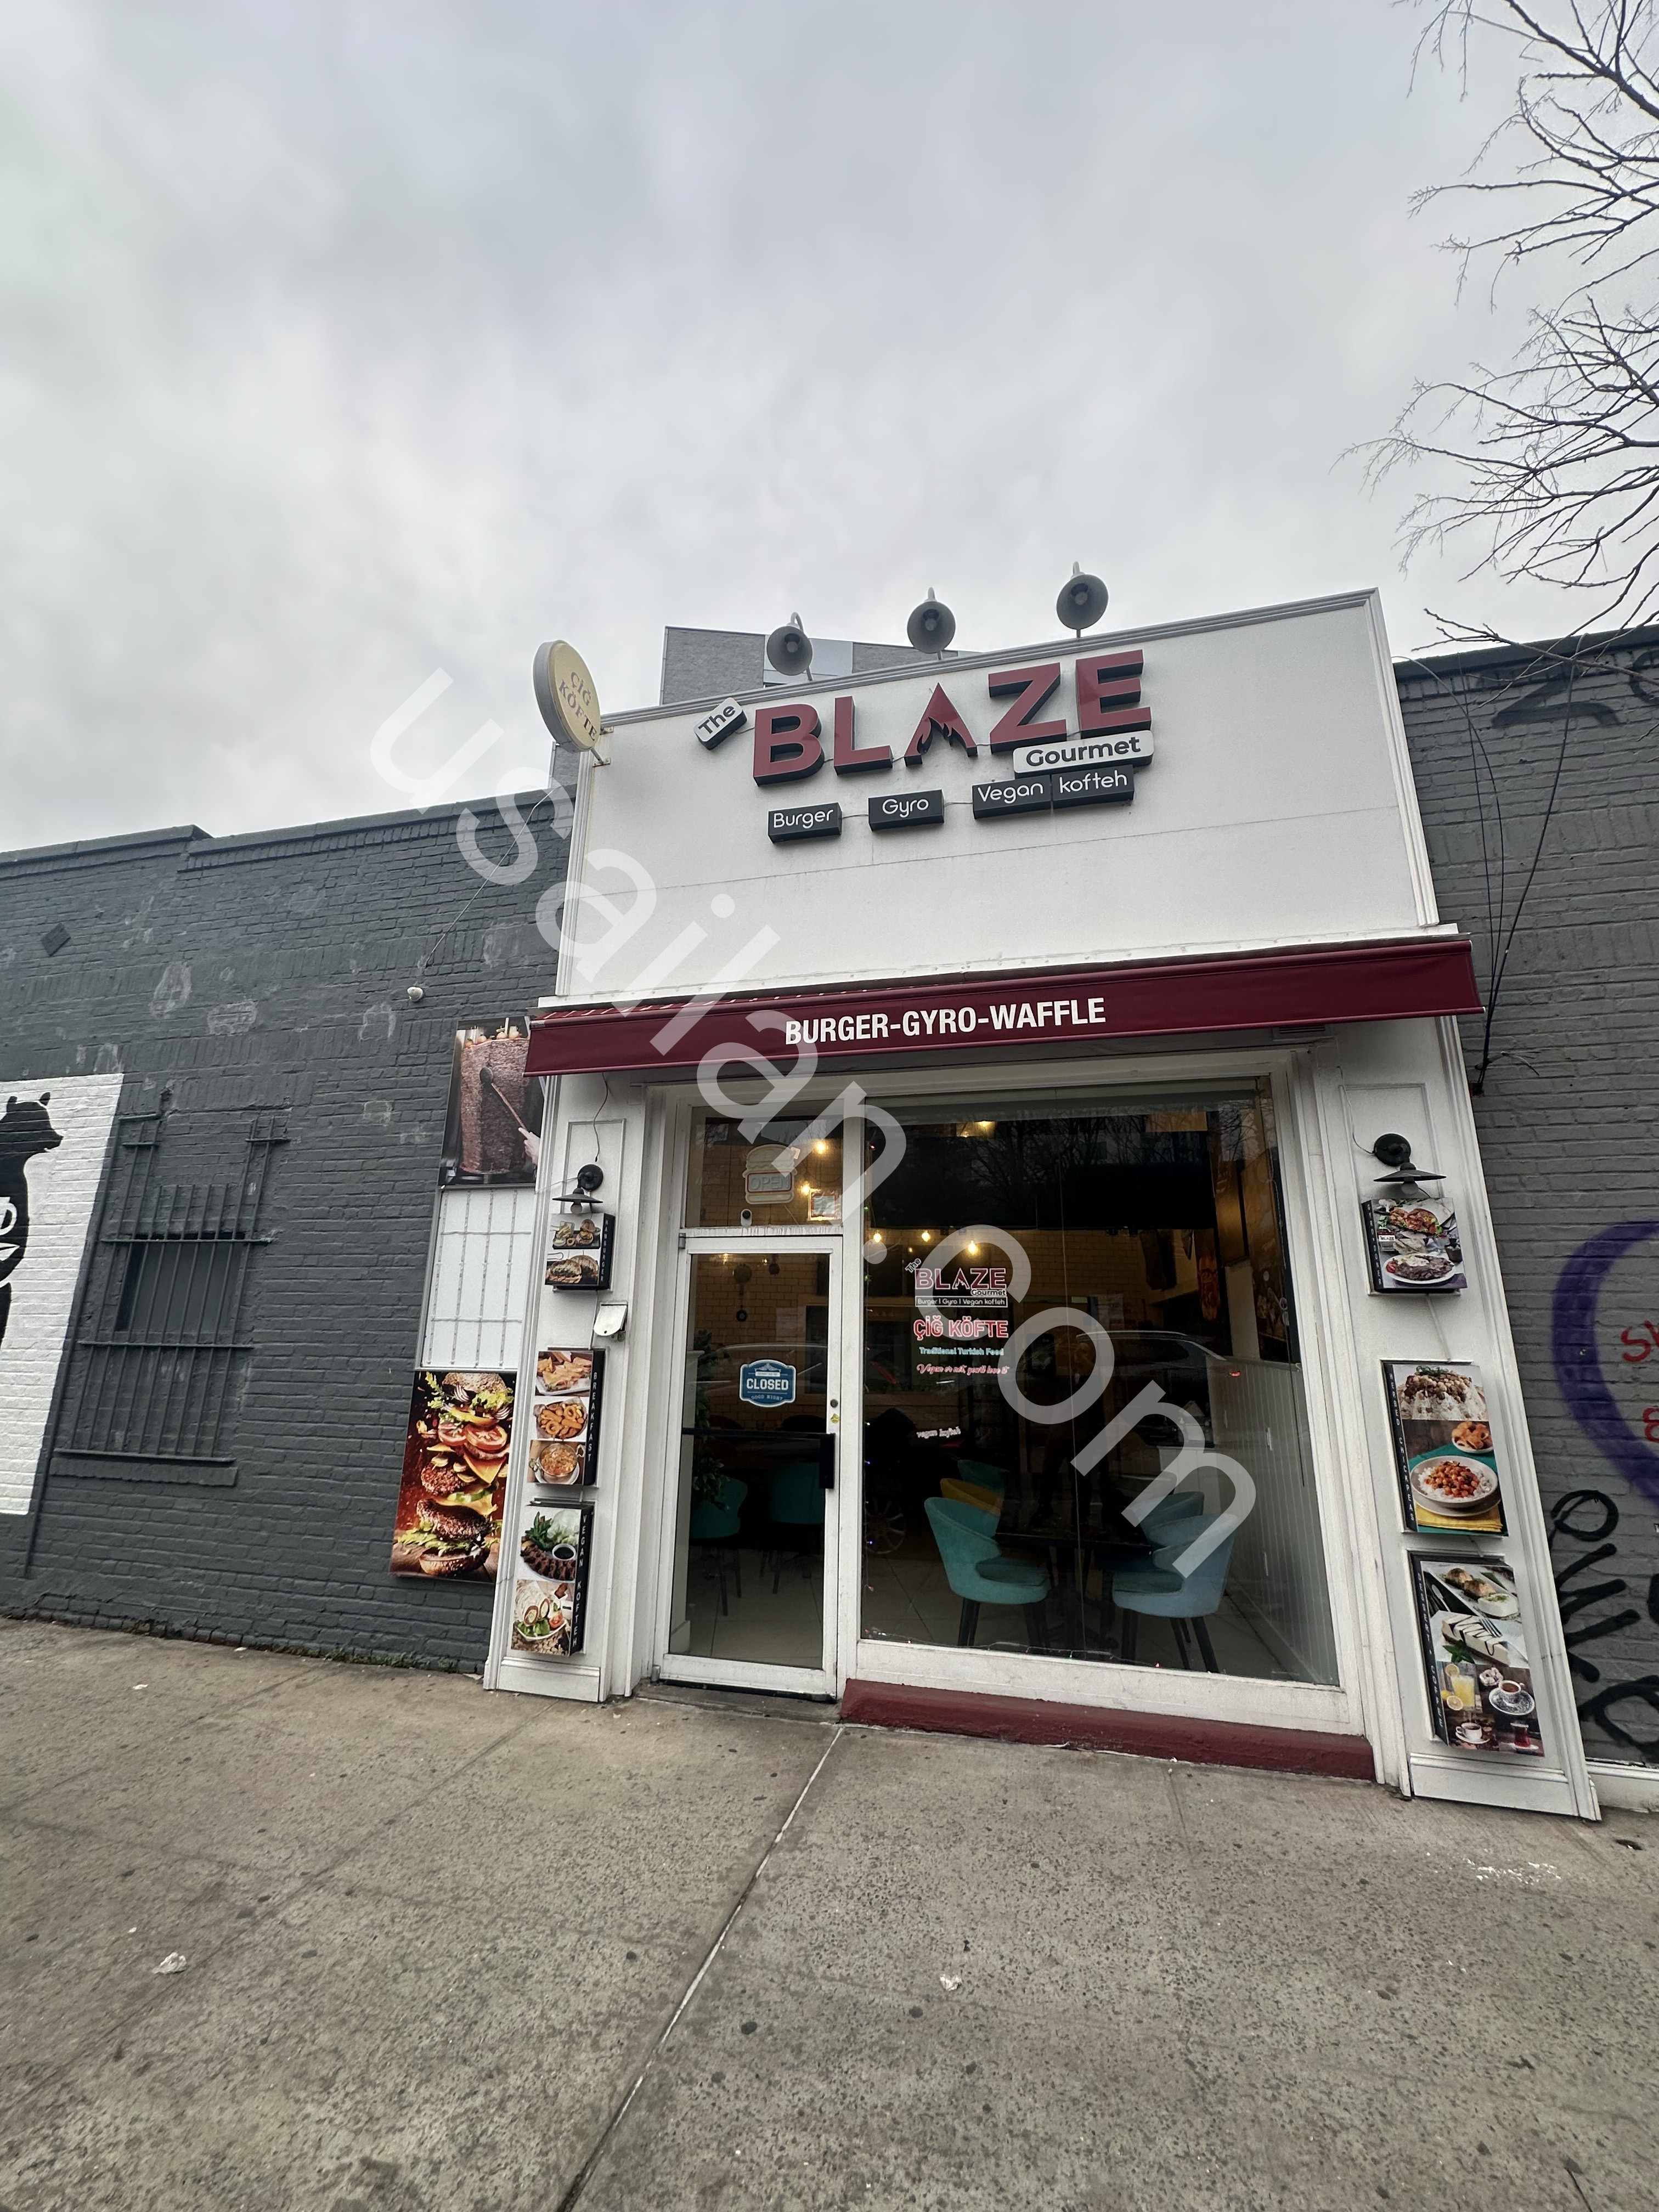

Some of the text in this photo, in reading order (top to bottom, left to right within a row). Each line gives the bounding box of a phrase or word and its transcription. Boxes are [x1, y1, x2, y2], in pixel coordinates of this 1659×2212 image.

[558, 679, 597, 741] KÖFTE
[698, 704, 735, 737] The
[753, 650, 1151, 785] BLAZE
[1026, 736, 1142, 767] Gourmet
[977, 769, 1128, 805] Vegan kofteh
[772, 808, 834, 829] Burger
[882, 797, 929, 819] Gyro
[785, 997, 1106, 1045] BURGER-GYRO-WAFFLE
[750, 1175, 790, 1190] OPEN
[600, 1219, 608, 1282] HAMBURGER
[905, 1258, 922, 1273] The
[915, 1268, 1007, 1290] BLAZE
[913, 1315, 1008, 1340] ÇİĞ KÖFTE
[919, 1347, 957, 1355] Traditional
[986, 1347, 1004, 1356] Food
[747, 1378, 789, 1390] CLOSED
[917, 1364, 944, 1375] Vegan
[588, 1372, 597, 1462] BREAKFAST
[1399, 1437, 1415, 1521] CHICKPEAS
[573, 1514, 588, 1646] VEGAN KOFTEH
[1418, 1572, 1443, 1728] DESSERT COFFEE
